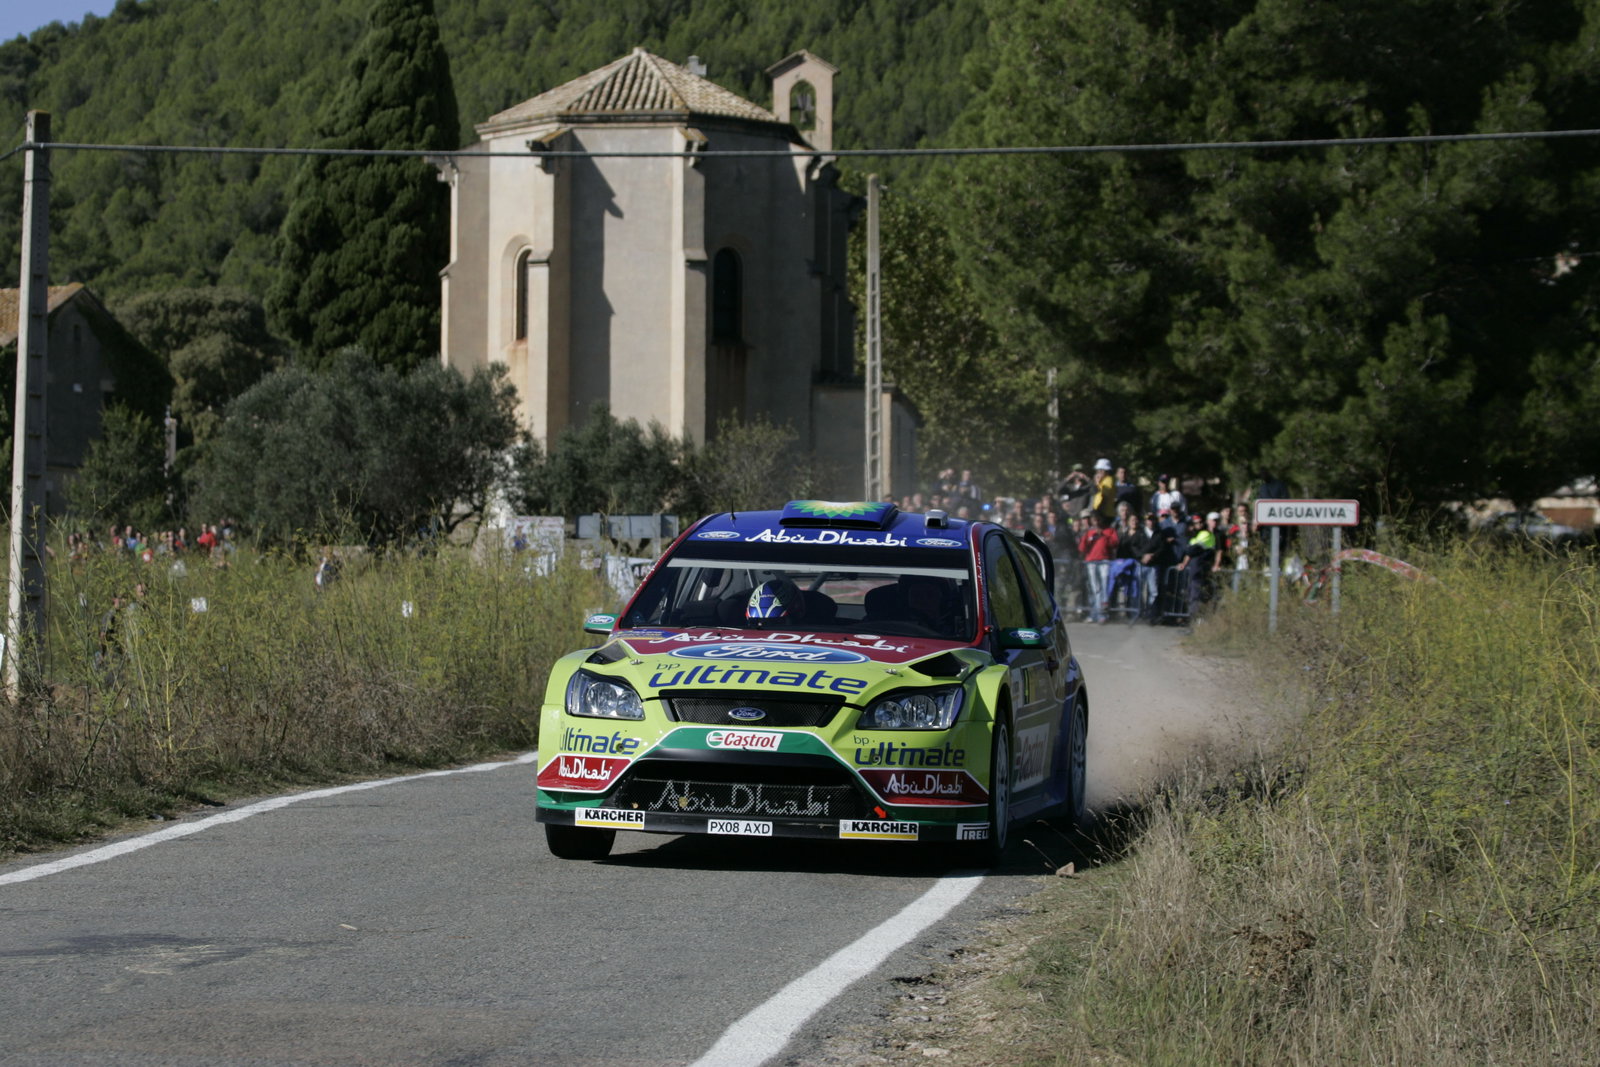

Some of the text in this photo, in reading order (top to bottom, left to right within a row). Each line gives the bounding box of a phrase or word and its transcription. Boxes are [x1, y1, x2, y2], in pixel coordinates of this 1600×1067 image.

[1267, 506, 1347, 519] AIGUAVIVA
[703, 643, 832, 661] Ford
[656, 663, 681, 671] bp
[648, 664, 868, 695] ultimate
[724, 732, 777, 748] Castrol
[853, 735, 870, 746] bp
[855, 742, 965, 767] ultimate
[585, 809, 644, 822] KÄRCHER
[709, 821, 771, 834] PX08 AXD
[851, 821, 918, 834] KÄRCHER
